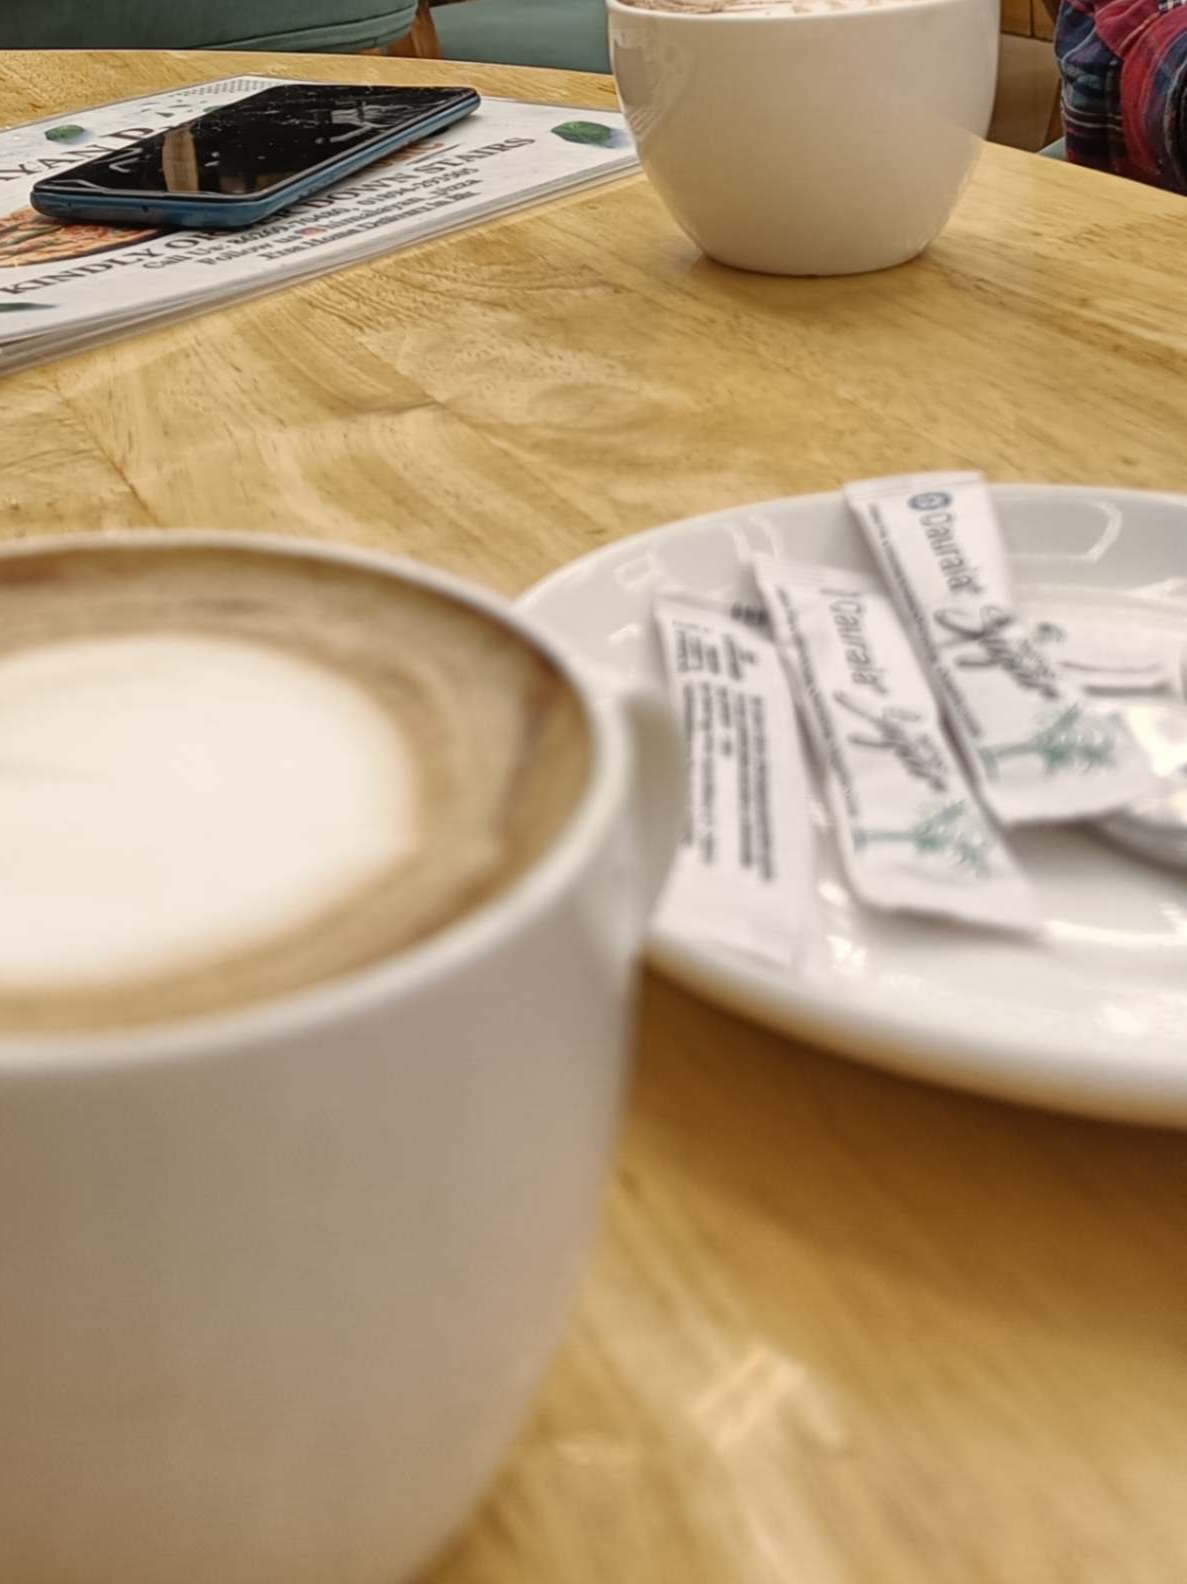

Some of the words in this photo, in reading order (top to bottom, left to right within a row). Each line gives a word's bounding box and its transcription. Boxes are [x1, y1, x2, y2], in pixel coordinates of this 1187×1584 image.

[308, 172, 419, 209] DOWN
[413, 137, 536, 175] STAIRS
[142, 254, 192, 269] Call
